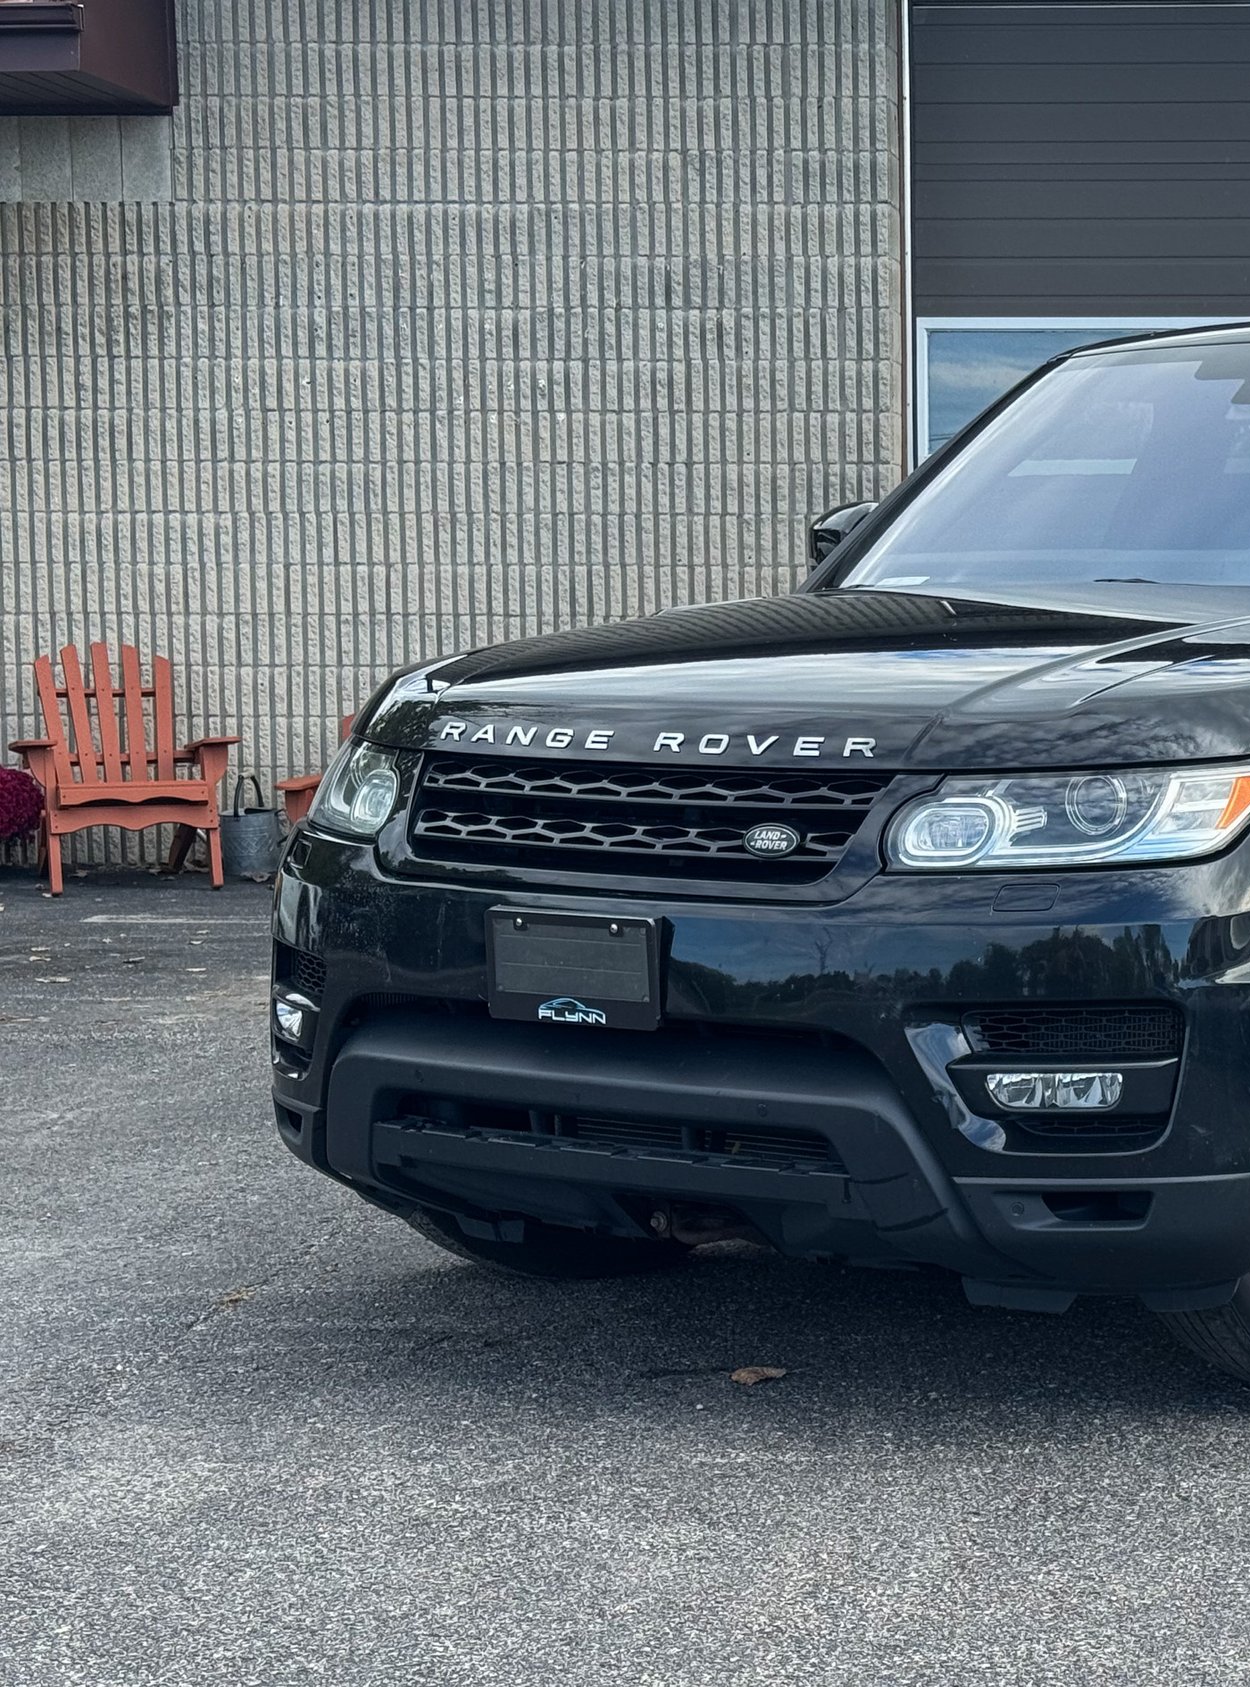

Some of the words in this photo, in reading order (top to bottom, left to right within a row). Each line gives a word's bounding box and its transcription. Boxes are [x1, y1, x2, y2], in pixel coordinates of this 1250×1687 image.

[440, 721, 615, 750] RANGE
[653, 732, 876, 758] ROVER
[538, 1009, 606, 1024] FLYNN
